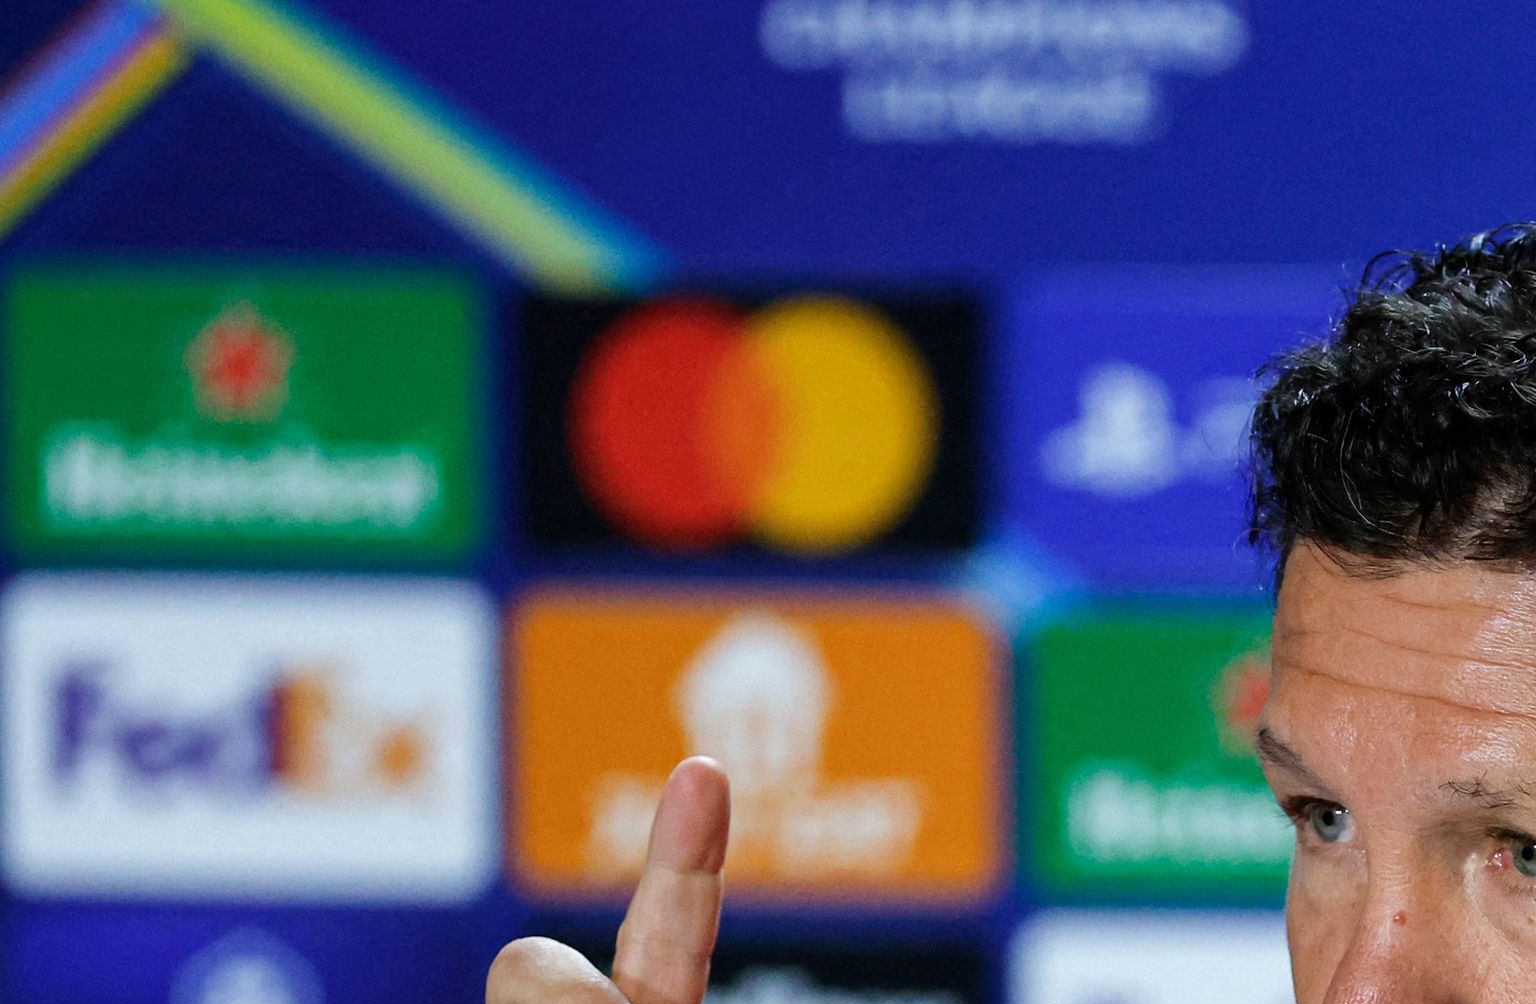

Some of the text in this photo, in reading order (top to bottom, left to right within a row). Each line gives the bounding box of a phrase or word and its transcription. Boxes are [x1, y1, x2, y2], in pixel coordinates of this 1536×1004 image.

[48, 434, 436, 525] Heineken
[52, 655, 442, 797] FedEx
[1070, 772, 1297, 862] Heine
